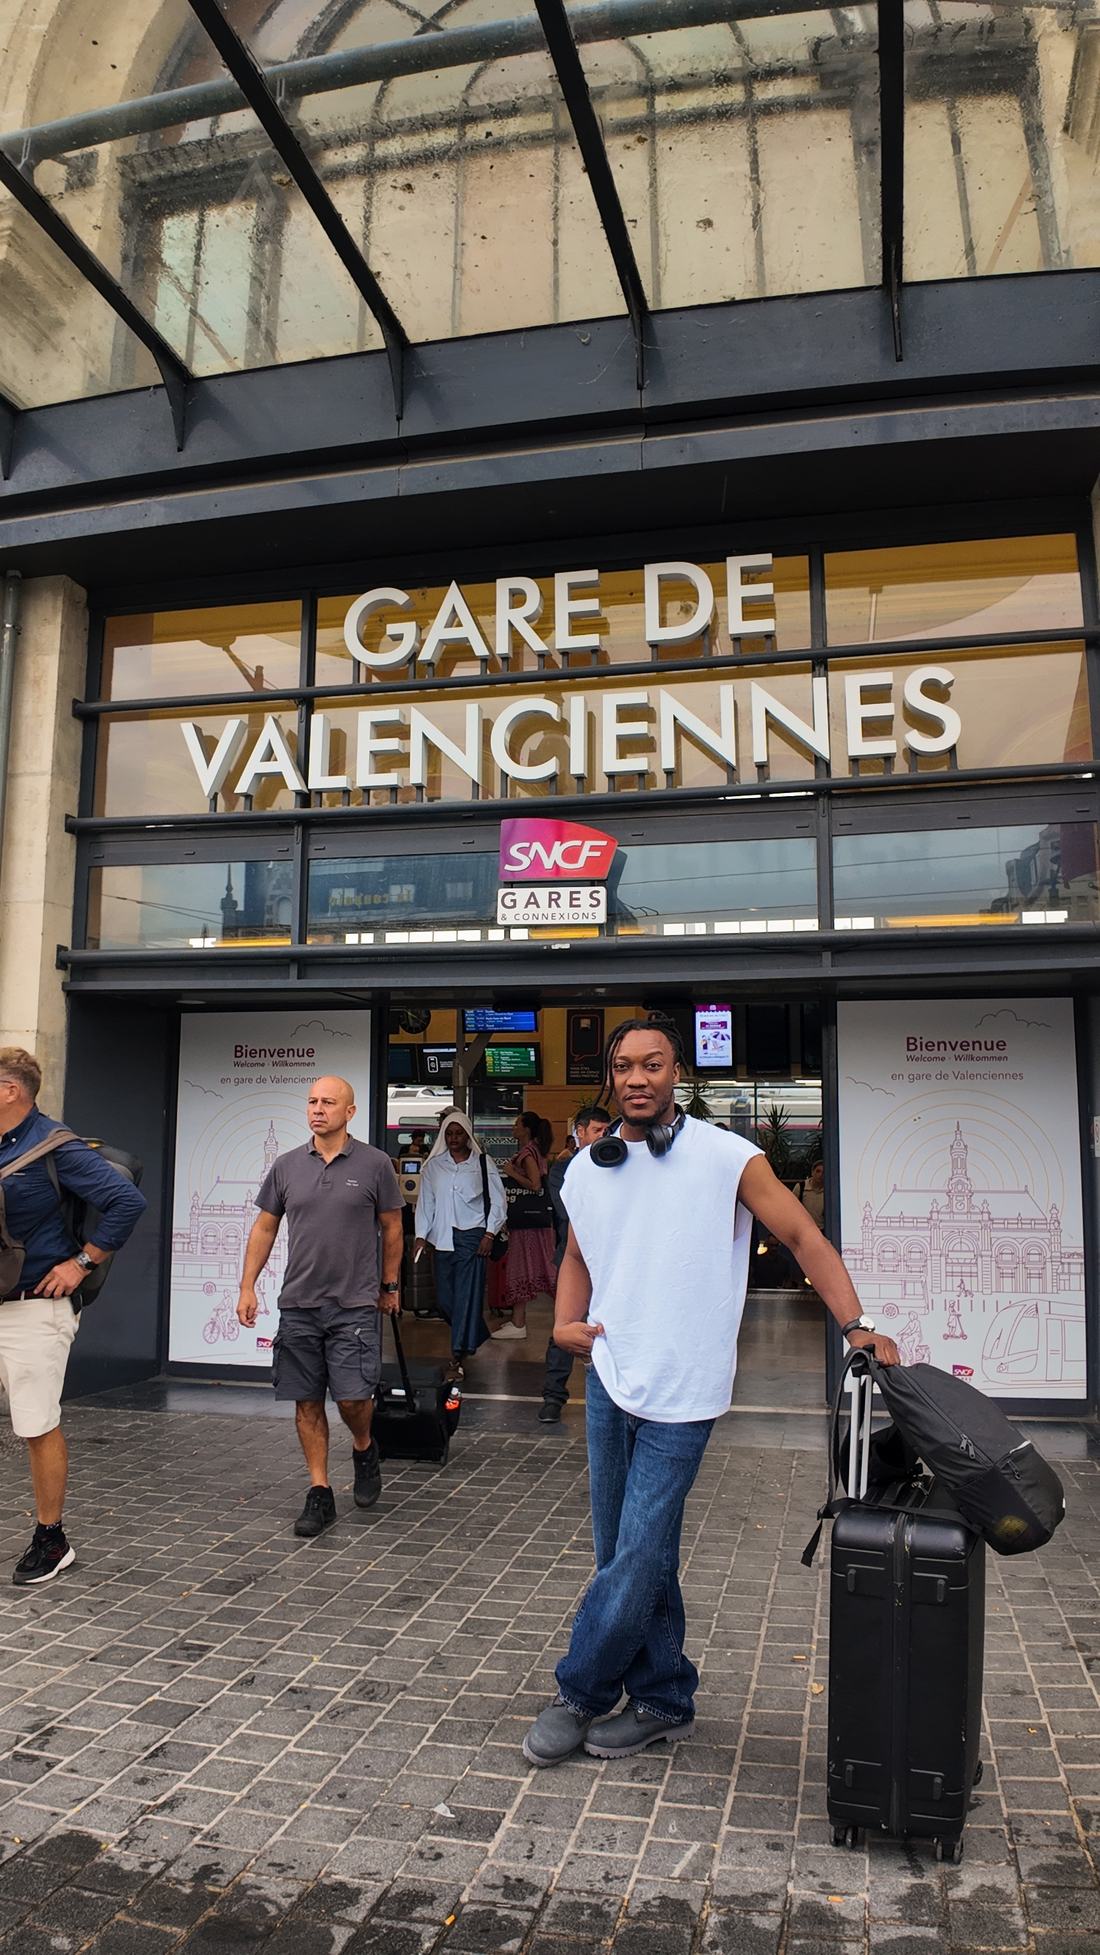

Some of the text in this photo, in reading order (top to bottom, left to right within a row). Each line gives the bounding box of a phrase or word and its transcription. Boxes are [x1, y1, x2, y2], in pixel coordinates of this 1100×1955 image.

[343, 553, 775, 671] GARE DE
[180, 666, 962, 799] VALENCIENNES
[504, 840, 608, 871] SNCF
[501, 890, 601, 909] GARES
[514, 912, 597, 921] CONNEXIONS
[234, 1044, 315, 1059] Bienvenue
[906, 1036, 1007, 1052] Bienvenue
[271, 1060, 316, 1068] Willkommen
[906, 1053, 1008, 1062] Welcome Willkommen
[220, 1074, 322, 1087] en gare de Valencienn
[891, 1069, 1024, 1084] en gare de Valenciennes
